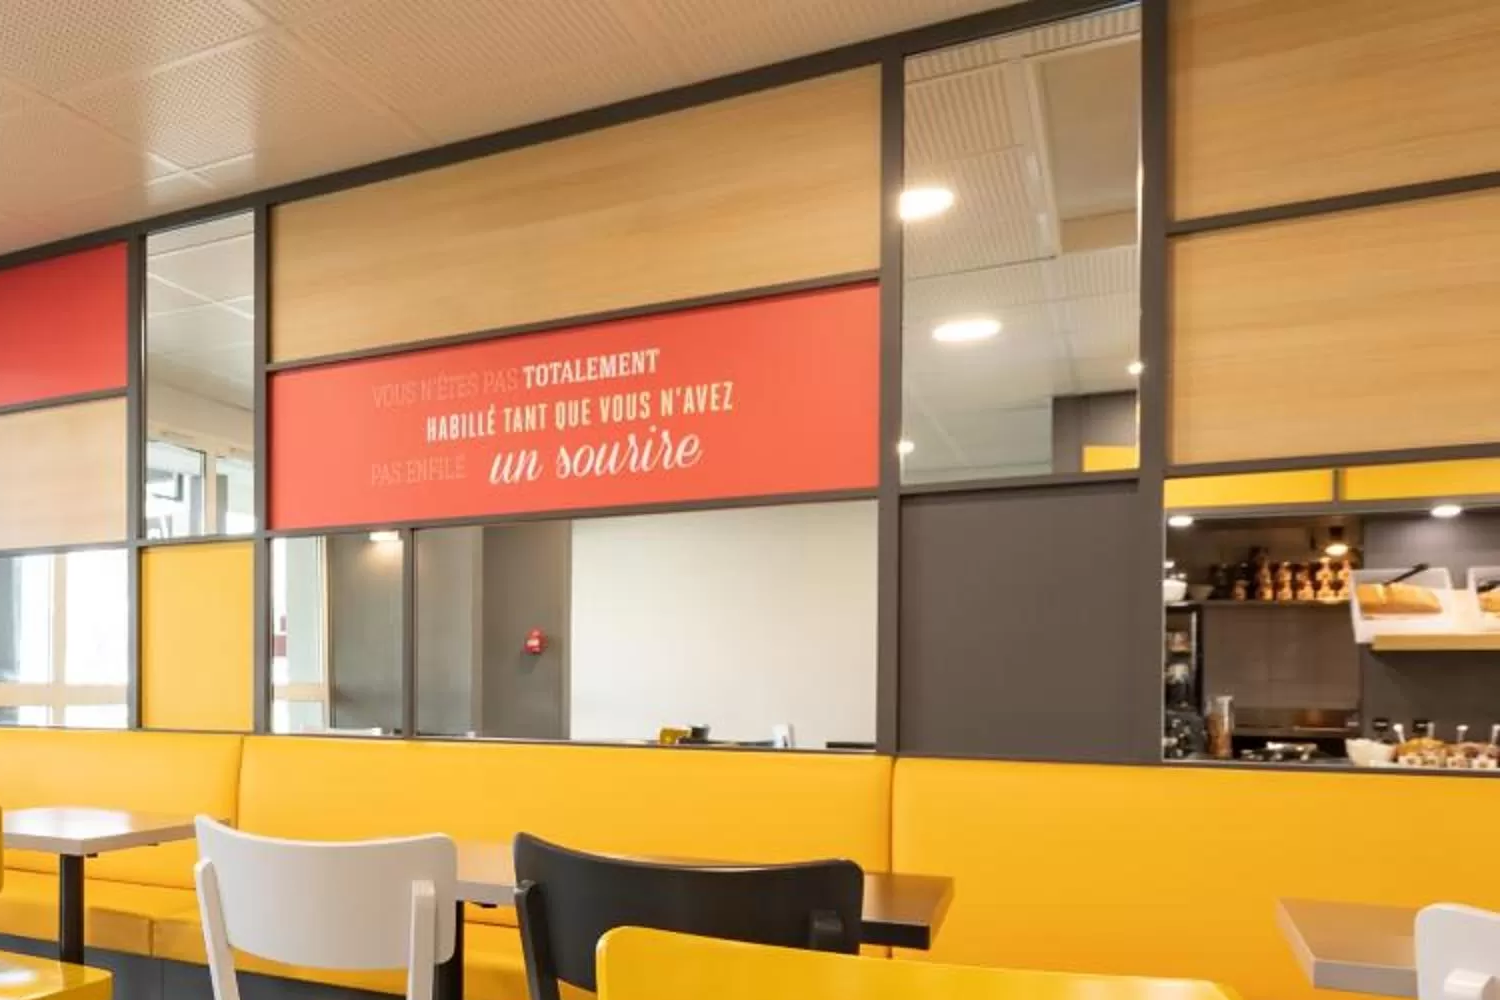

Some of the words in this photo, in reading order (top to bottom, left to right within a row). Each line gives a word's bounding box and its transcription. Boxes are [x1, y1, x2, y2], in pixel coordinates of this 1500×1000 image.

[372, 380, 417, 408] VOUS
[483, 367, 519, 393] PAS
[522, 348, 661, 389] TOTALEMENT
[426, 403, 497, 444] HABILLÉ
[503, 402, 548, 433] TANT
[555, 398, 591, 430] QUE
[600, 391, 651, 424] VOUS
[660, 381, 734, 417] N'AVEZ
[371, 460, 402, 487] PAS
[488, 447, 544, 485] un
[555, 424, 704, 480] sourire
